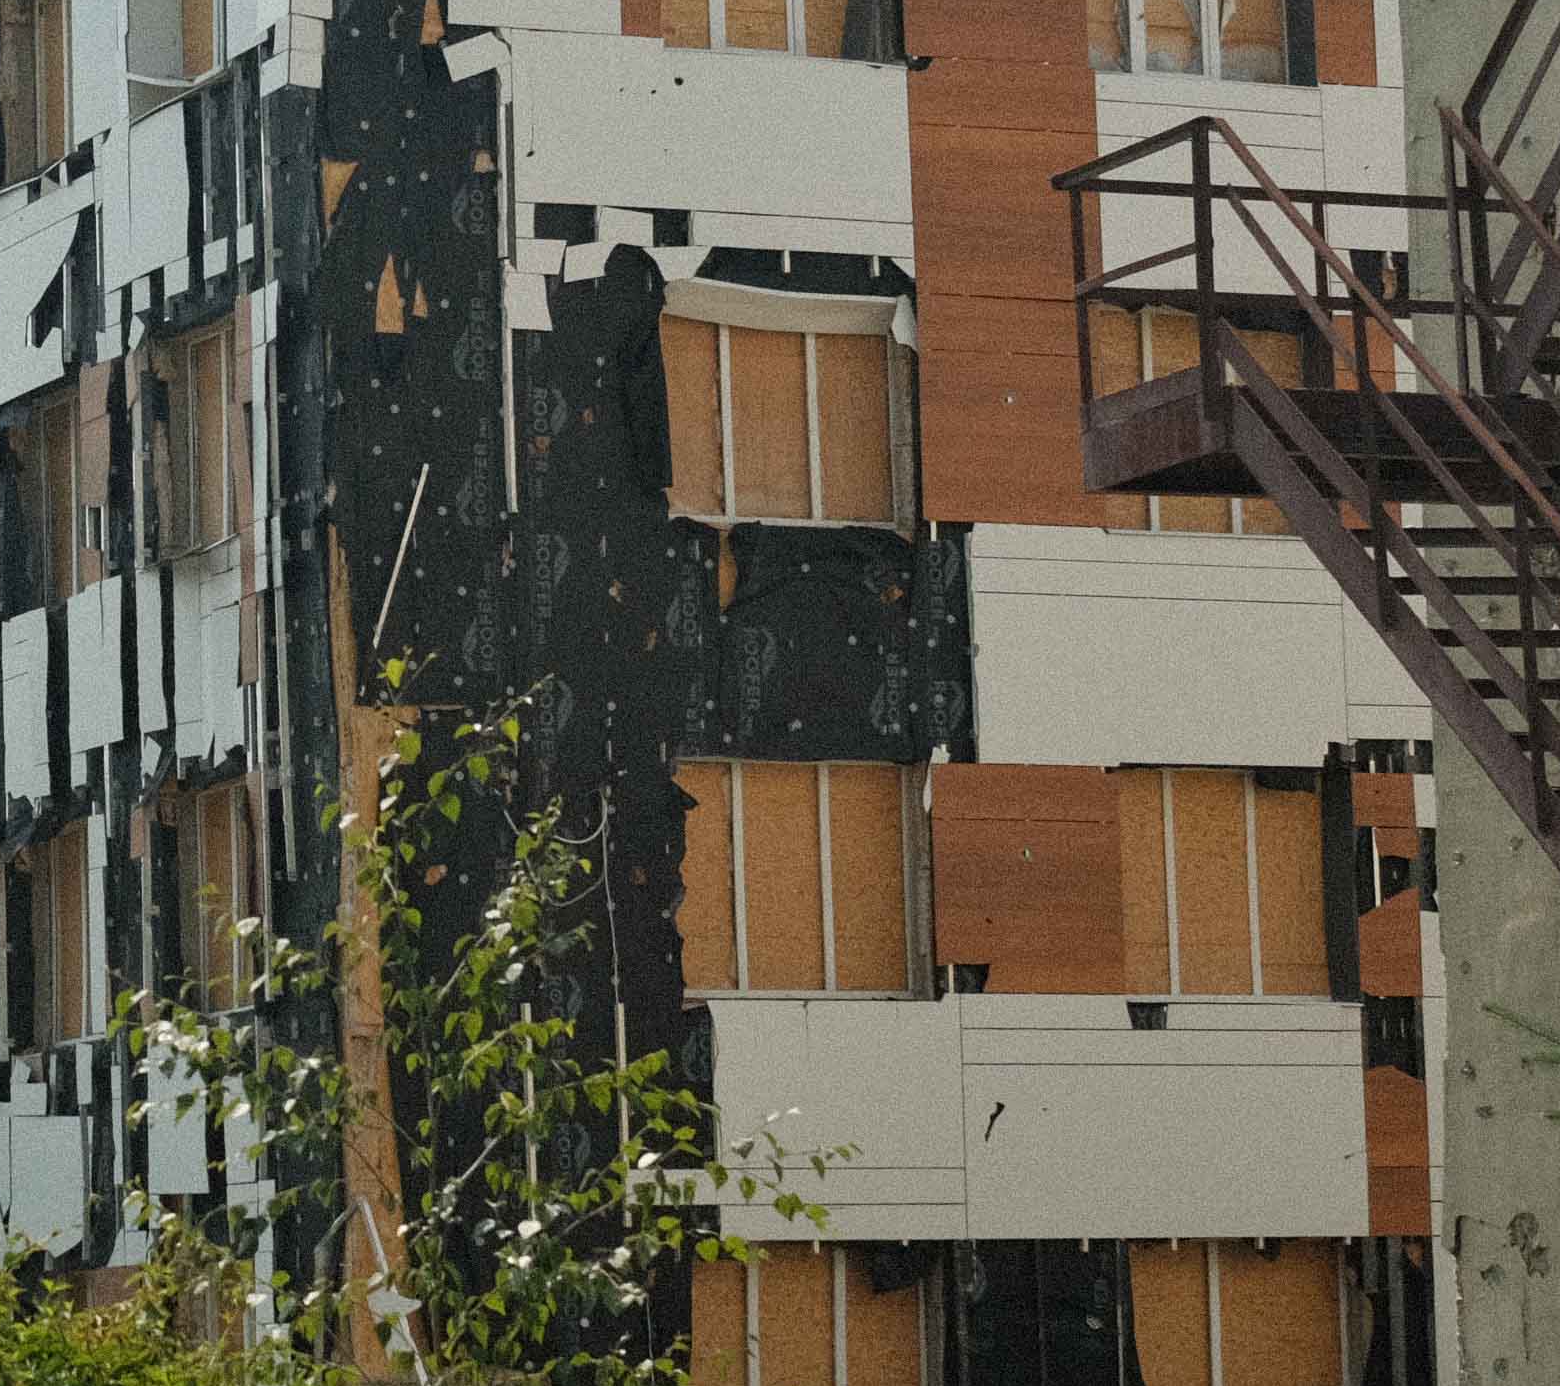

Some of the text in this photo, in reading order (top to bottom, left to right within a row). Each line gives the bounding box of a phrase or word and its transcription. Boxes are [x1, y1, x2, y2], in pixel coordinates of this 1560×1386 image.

[470, 297, 486, 382] ROOFER
[473, 443, 487, 527] ROOFER
[536, 533, 553, 619] ROOFER
[478, 587, 495, 672] ROOFER
[743, 627, 761, 711] ROOFER
